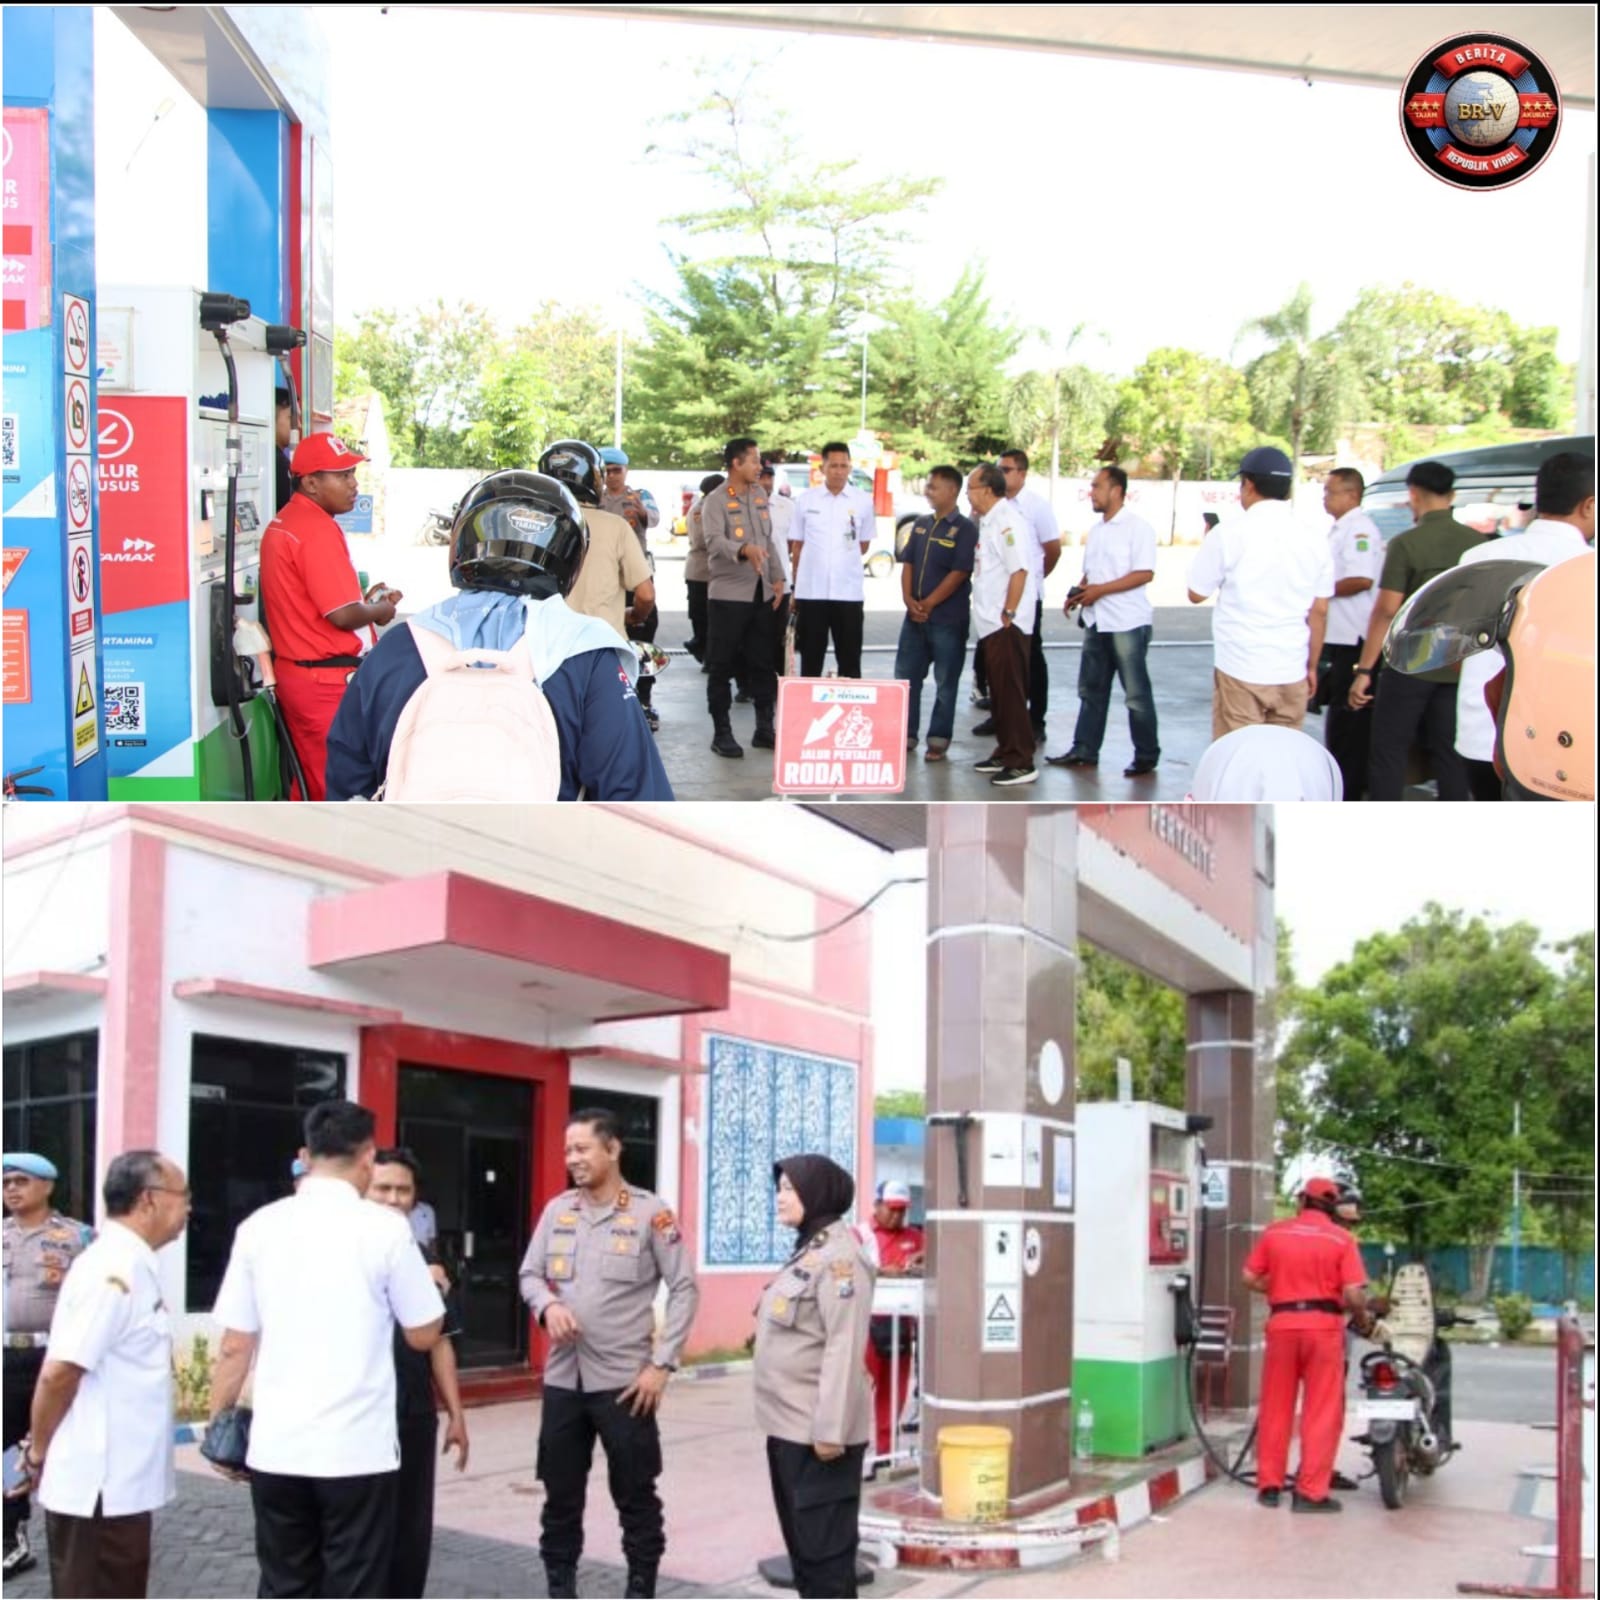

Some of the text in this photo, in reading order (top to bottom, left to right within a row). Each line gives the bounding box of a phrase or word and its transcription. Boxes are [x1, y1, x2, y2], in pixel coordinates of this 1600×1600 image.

[99, 463, 139, 478] LUR
[800, 749, 884, 760] JALUR PERTALITE
[784, 762, 895, 785] RODA DUA
